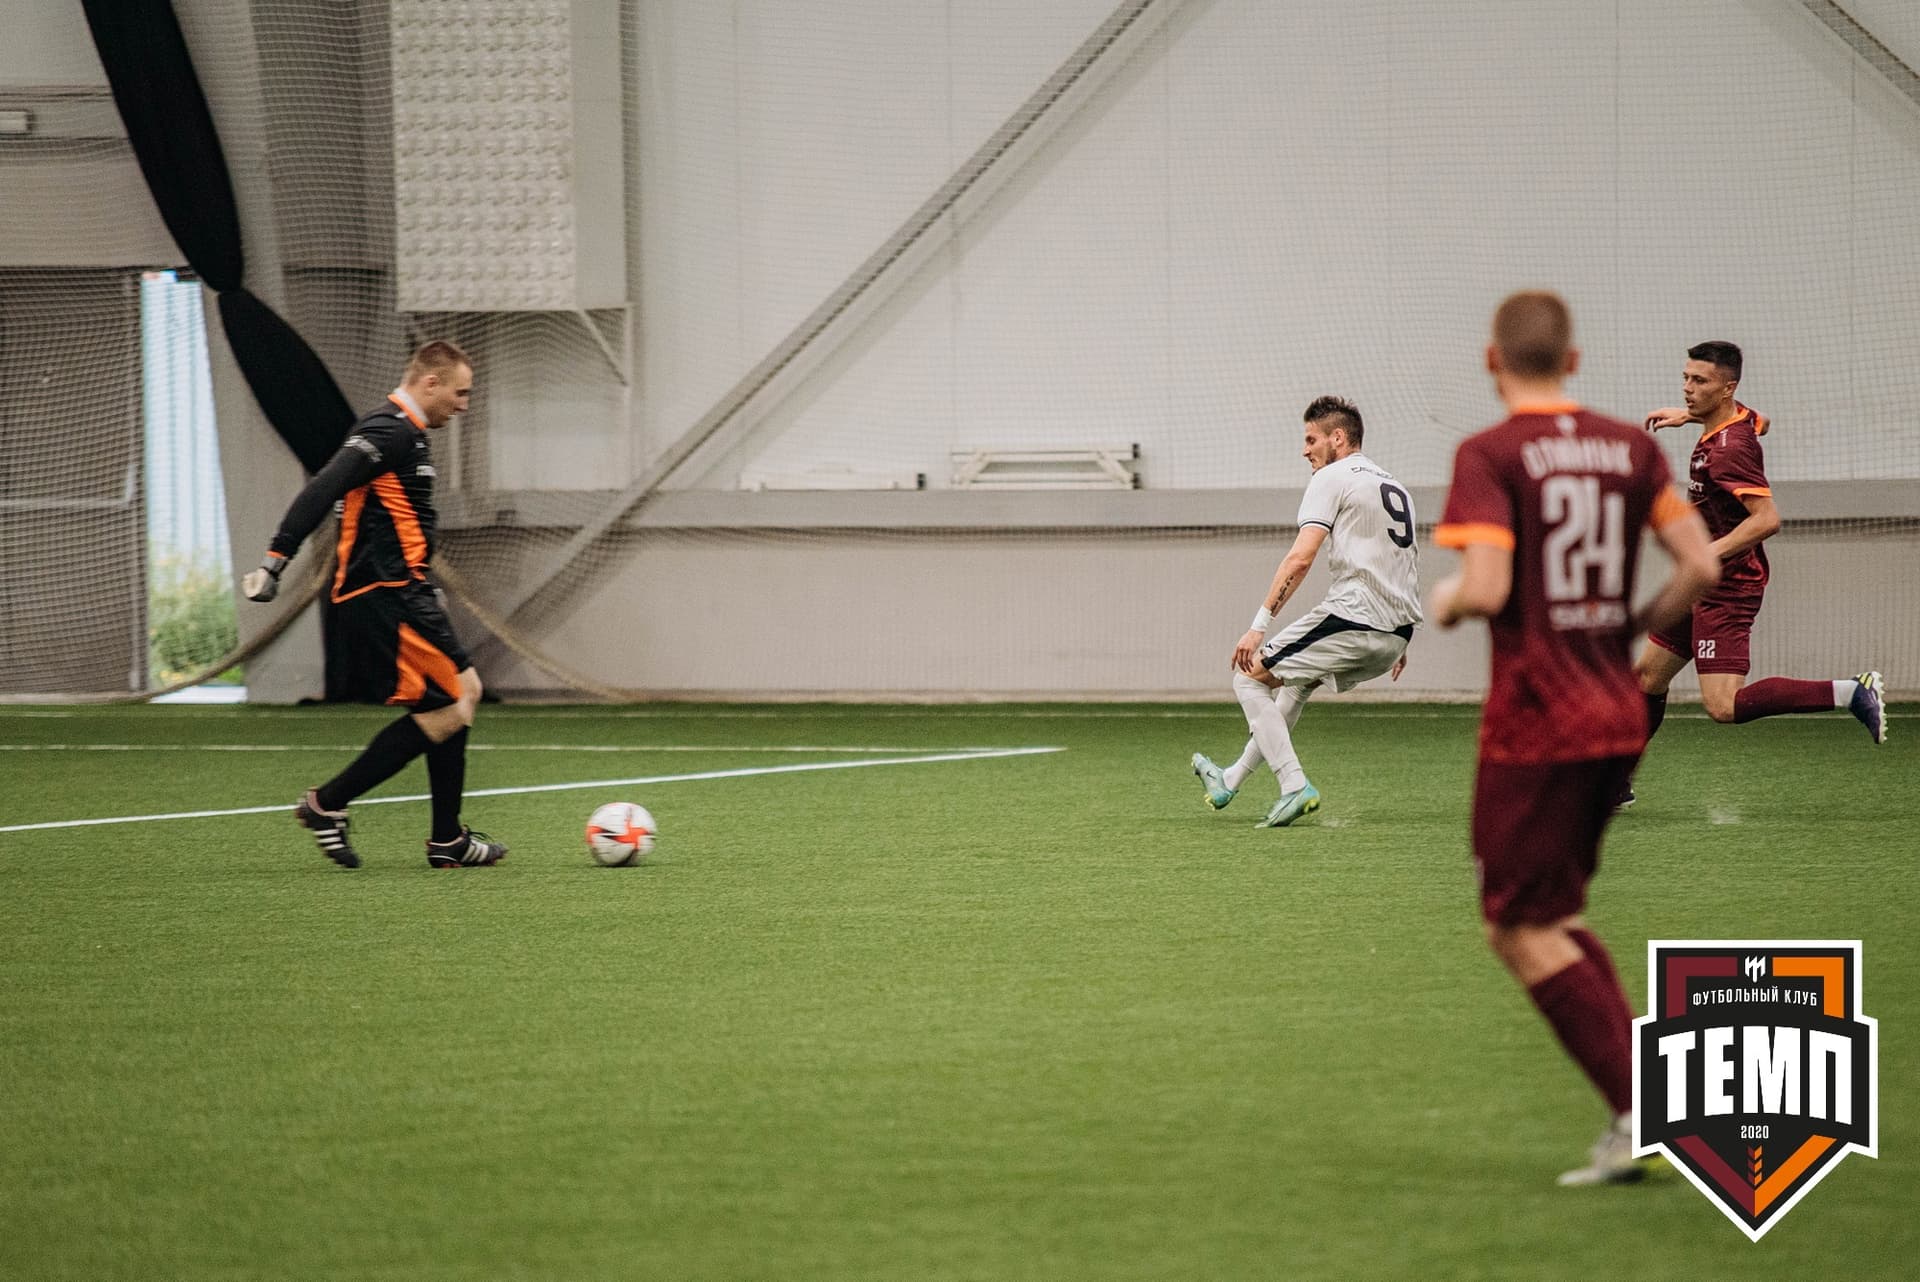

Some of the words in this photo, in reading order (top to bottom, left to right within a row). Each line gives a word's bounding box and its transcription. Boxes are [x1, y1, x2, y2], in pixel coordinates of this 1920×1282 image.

[1380, 482, 1413, 548] 9
[1544, 476, 1625, 600] 24
[1698, 639, 1716, 659] 22
